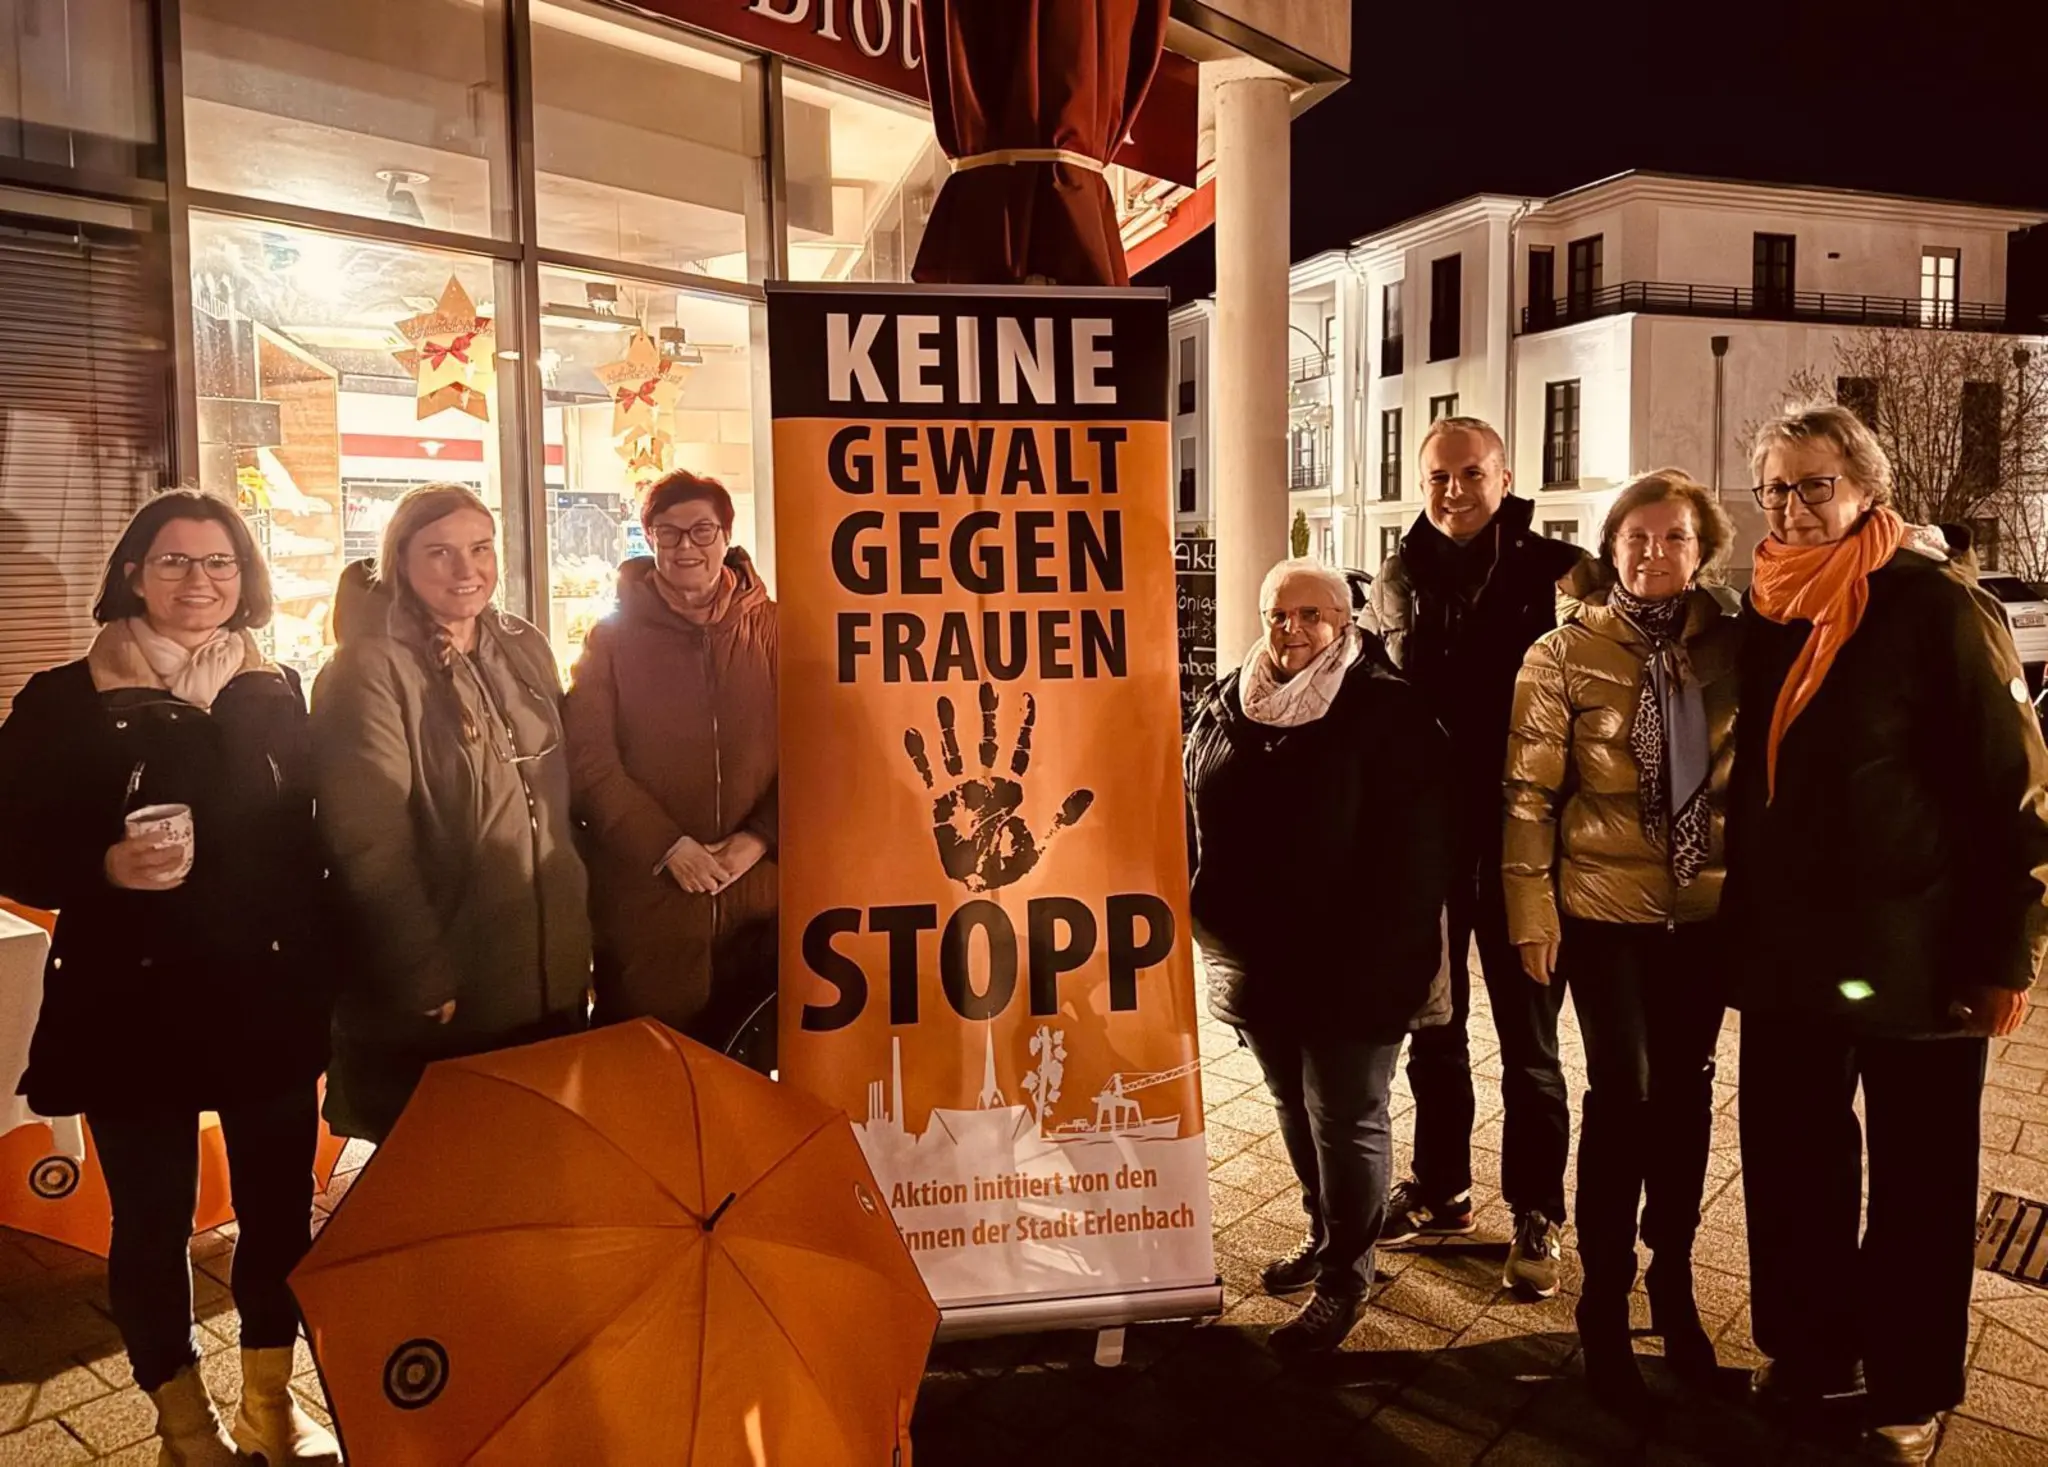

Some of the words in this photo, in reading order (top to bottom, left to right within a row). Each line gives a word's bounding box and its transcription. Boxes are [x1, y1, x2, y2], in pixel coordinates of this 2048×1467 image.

[826, 313, 1117, 405] KEINE
[827, 425, 1127, 495] GEWALT
[831, 510, 1124, 595] GEGEN
[837, 609, 1128, 683] FRAUEN
[801, 893, 1176, 1031] STOPP
[891, 1180, 967, 1209] Aktion
[974, 1171, 1064, 1201] initiiert
[1068, 1173, 1109, 1193] von
[1115, 1164, 1158, 1190] den
[972, 1218, 1010, 1245] der
[1016, 1211, 1078, 1242] Stadt
[1084, 1202, 1195, 1236] Erlenbach
